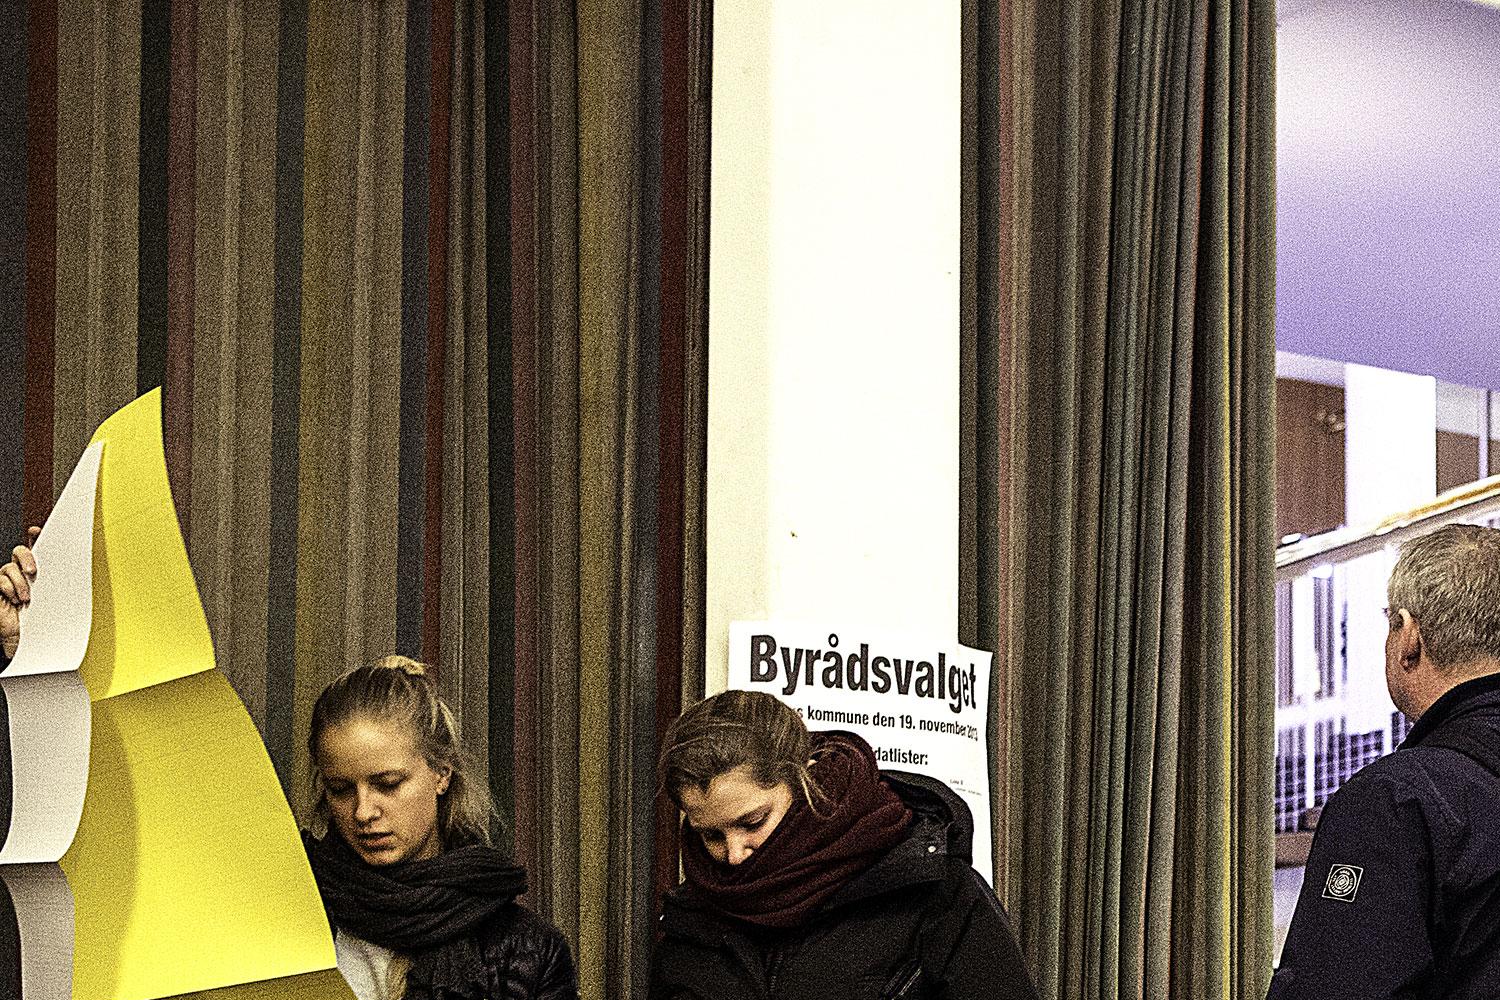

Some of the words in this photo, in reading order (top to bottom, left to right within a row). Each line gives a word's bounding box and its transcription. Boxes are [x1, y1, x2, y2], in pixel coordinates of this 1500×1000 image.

[750, 634, 976, 713] Byrådsvalget
[807, 705, 869, 726] kommune
[873, 713, 895, 728] den
[900, 716, 917, 730] 19.
[920, 719, 966, 737] november
